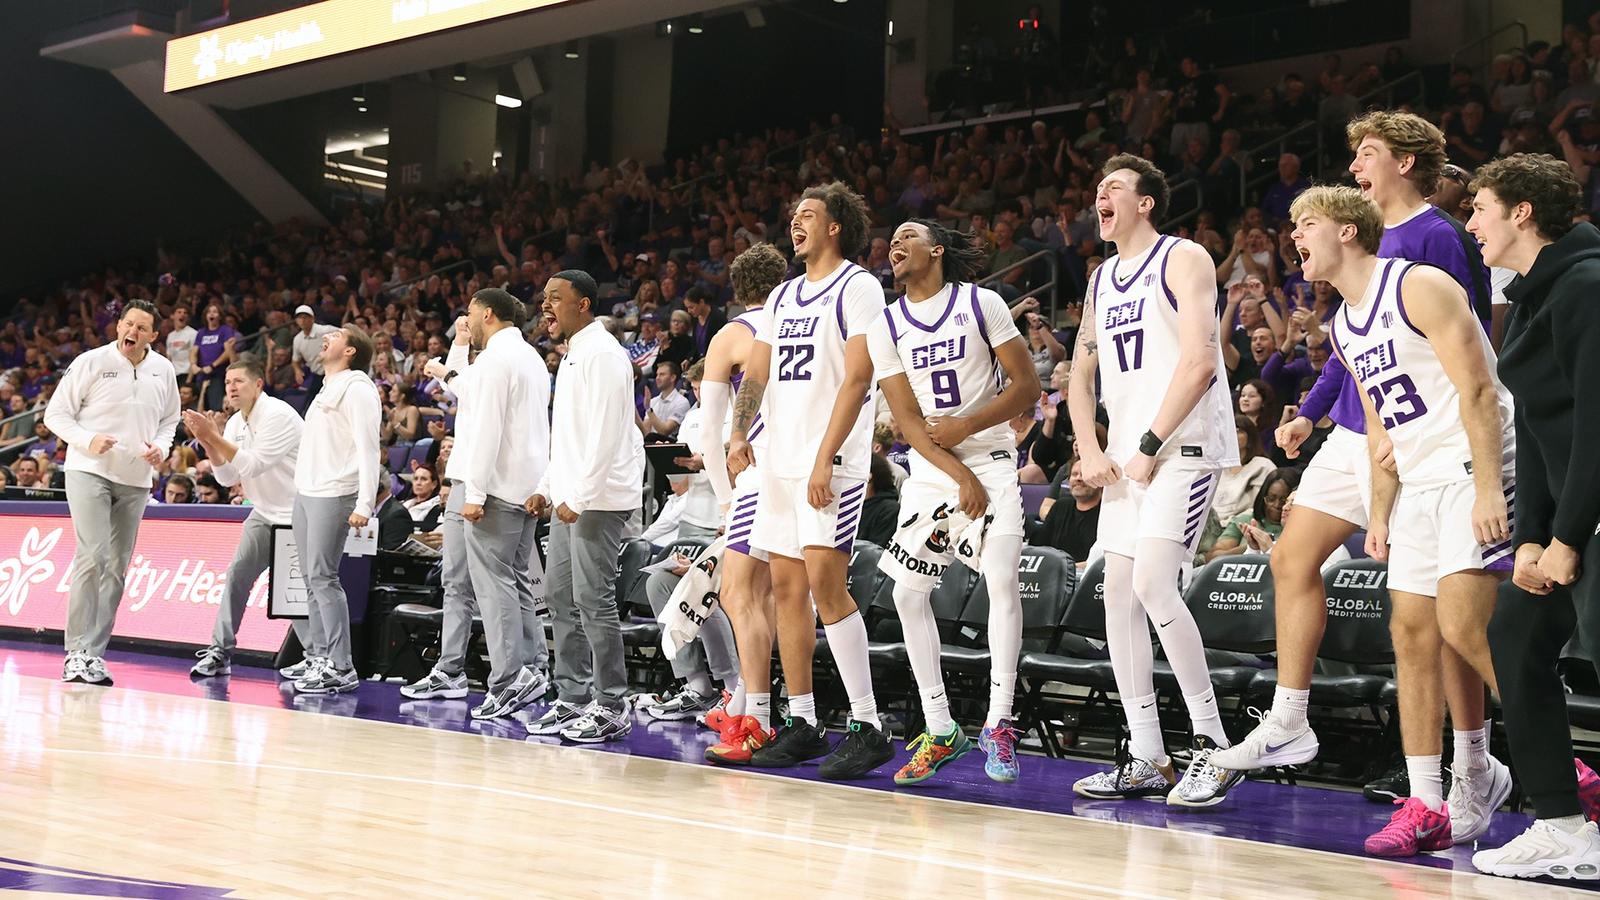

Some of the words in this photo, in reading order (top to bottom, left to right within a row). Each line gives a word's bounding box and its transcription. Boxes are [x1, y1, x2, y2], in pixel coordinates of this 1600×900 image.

[778, 316, 819, 339] GCU
[1105, 297, 1145, 330] GCU
[779, 344, 814, 381] 22
[912, 335, 966, 379] GCU
[1112, 328, 1144, 372] 17
[1354, 339, 1397, 383] GCU
[931, 369, 961, 409] 9
[1367, 373, 1428, 431] 23
[1018, 555, 1045, 573] CU
[1216, 563, 1267, 582] GCU
[1333, 569, 1387, 589] GCU
[164, 559, 271, 608] Heah
[1209, 591, 1264, 603] GLOBAL
[1326, 597, 1383, 610] GLOBAL
[1327, 609, 1354, 618] REDIT
